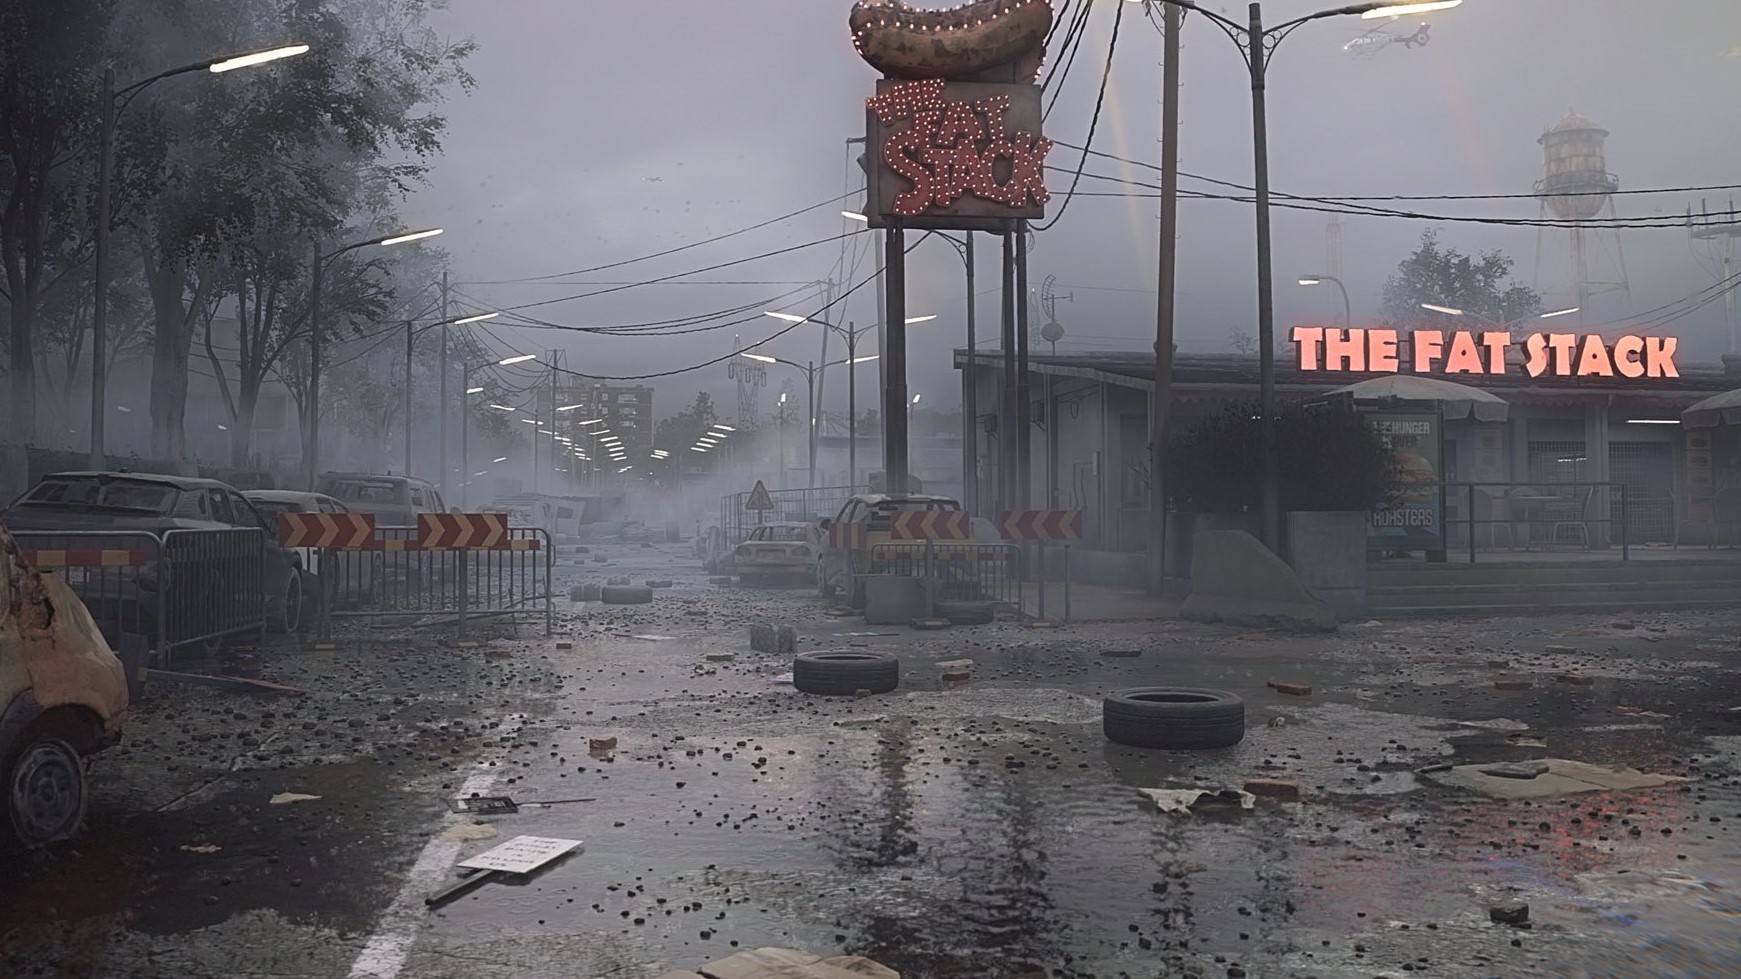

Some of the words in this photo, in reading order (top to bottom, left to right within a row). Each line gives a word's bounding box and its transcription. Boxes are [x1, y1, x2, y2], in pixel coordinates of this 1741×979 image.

[866, 77, 945, 126] THE
[914, 94, 1010, 150] FAT
[885, 130, 1054, 215] STACK
[1291, 326, 1399, 373] THE
[1412, 330, 1512, 374] FAT
[1525, 332, 1680, 378] STACK
[1392, 421, 1430, 434] HUNGER
[1373, 508, 1433, 526] ROASTERS
